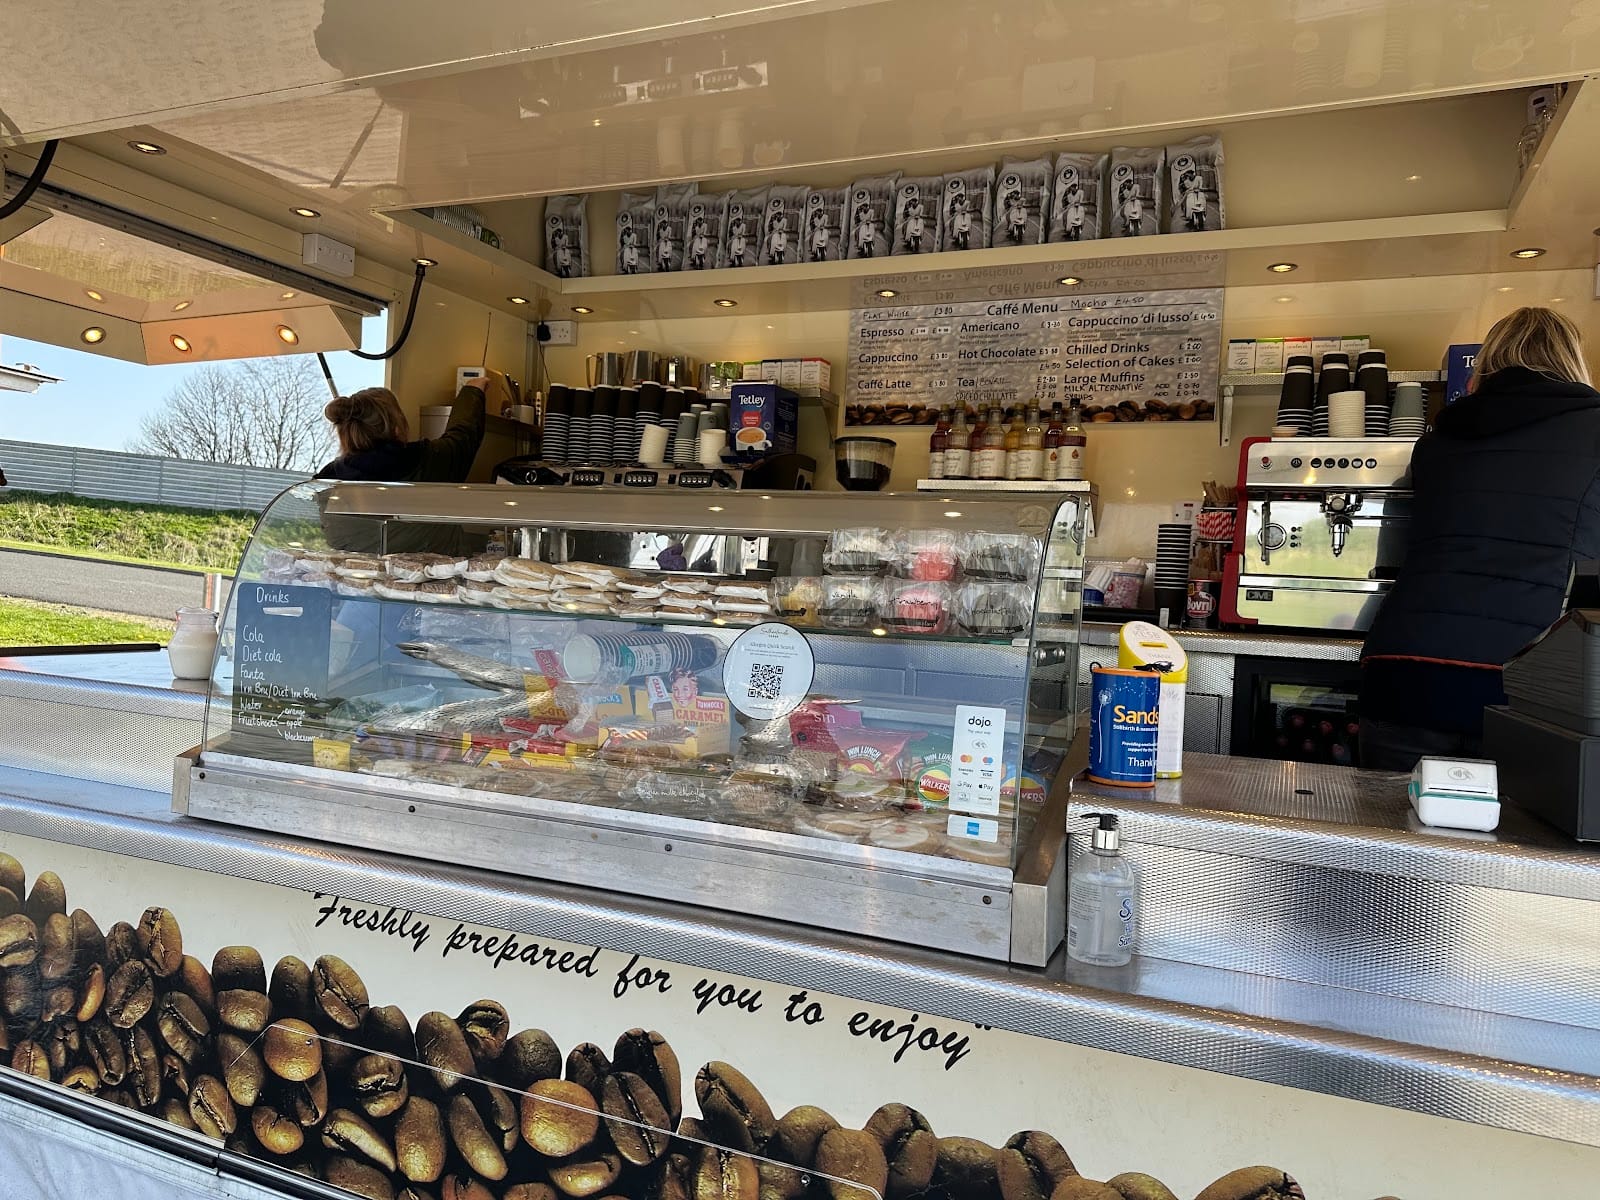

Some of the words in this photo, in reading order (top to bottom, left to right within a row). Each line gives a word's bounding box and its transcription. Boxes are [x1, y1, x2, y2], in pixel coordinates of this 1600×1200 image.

[988, 304, 1019, 316] Caffé
[1022, 303, 1058, 314] Menu
[961, 322, 1020, 333] Americano
[1068, 314, 1138, 328] Cappuccino
[860, 328, 904, 339] Espresso
[959, 349, 978, 359] Hot
[981, 347, 1036, 359] Chocolate
[1066, 344, 1107, 355] Chilled
[1111, 343, 1150, 353] Drinks
[859, 352, 918, 365] Cappuccino
[1064, 357, 1120, 369] Selection
[1124, 356, 1136, 367] of
[1139, 356, 1175, 367] Cakes
[858, 380, 883, 390] Caffé
[886, 379, 911, 389] Latte
[957, 378, 975, 387] Tea
[1064, 374, 1097, 386] Large
[1100, 372, 1145, 383] Muffins
[738, 394, 765, 408] Tetley
[256, 586, 290, 603] Drinks
[1187, 596, 1213, 611] Bovril
[243, 625, 265, 644] Cola
[243, 645, 262, 662] Diet
[264, 649, 283, 663] cola
[240, 664, 265, 681] Fanta
[240, 681, 253, 694] Irn
[303, 687, 318, 701] Bru
[240, 697, 263, 711] Water
[676, 710, 727, 723] CARAMEL
[861, 745, 882, 760] LUNCH
[920, 778, 951, 793] WALKERS
[314, 891, 430, 952] Freshly
[442, 924, 601, 978] prepared
[614, 954, 672, 999] for
[693, 978, 763, 1014] you
[785, 990, 824, 1025] to
